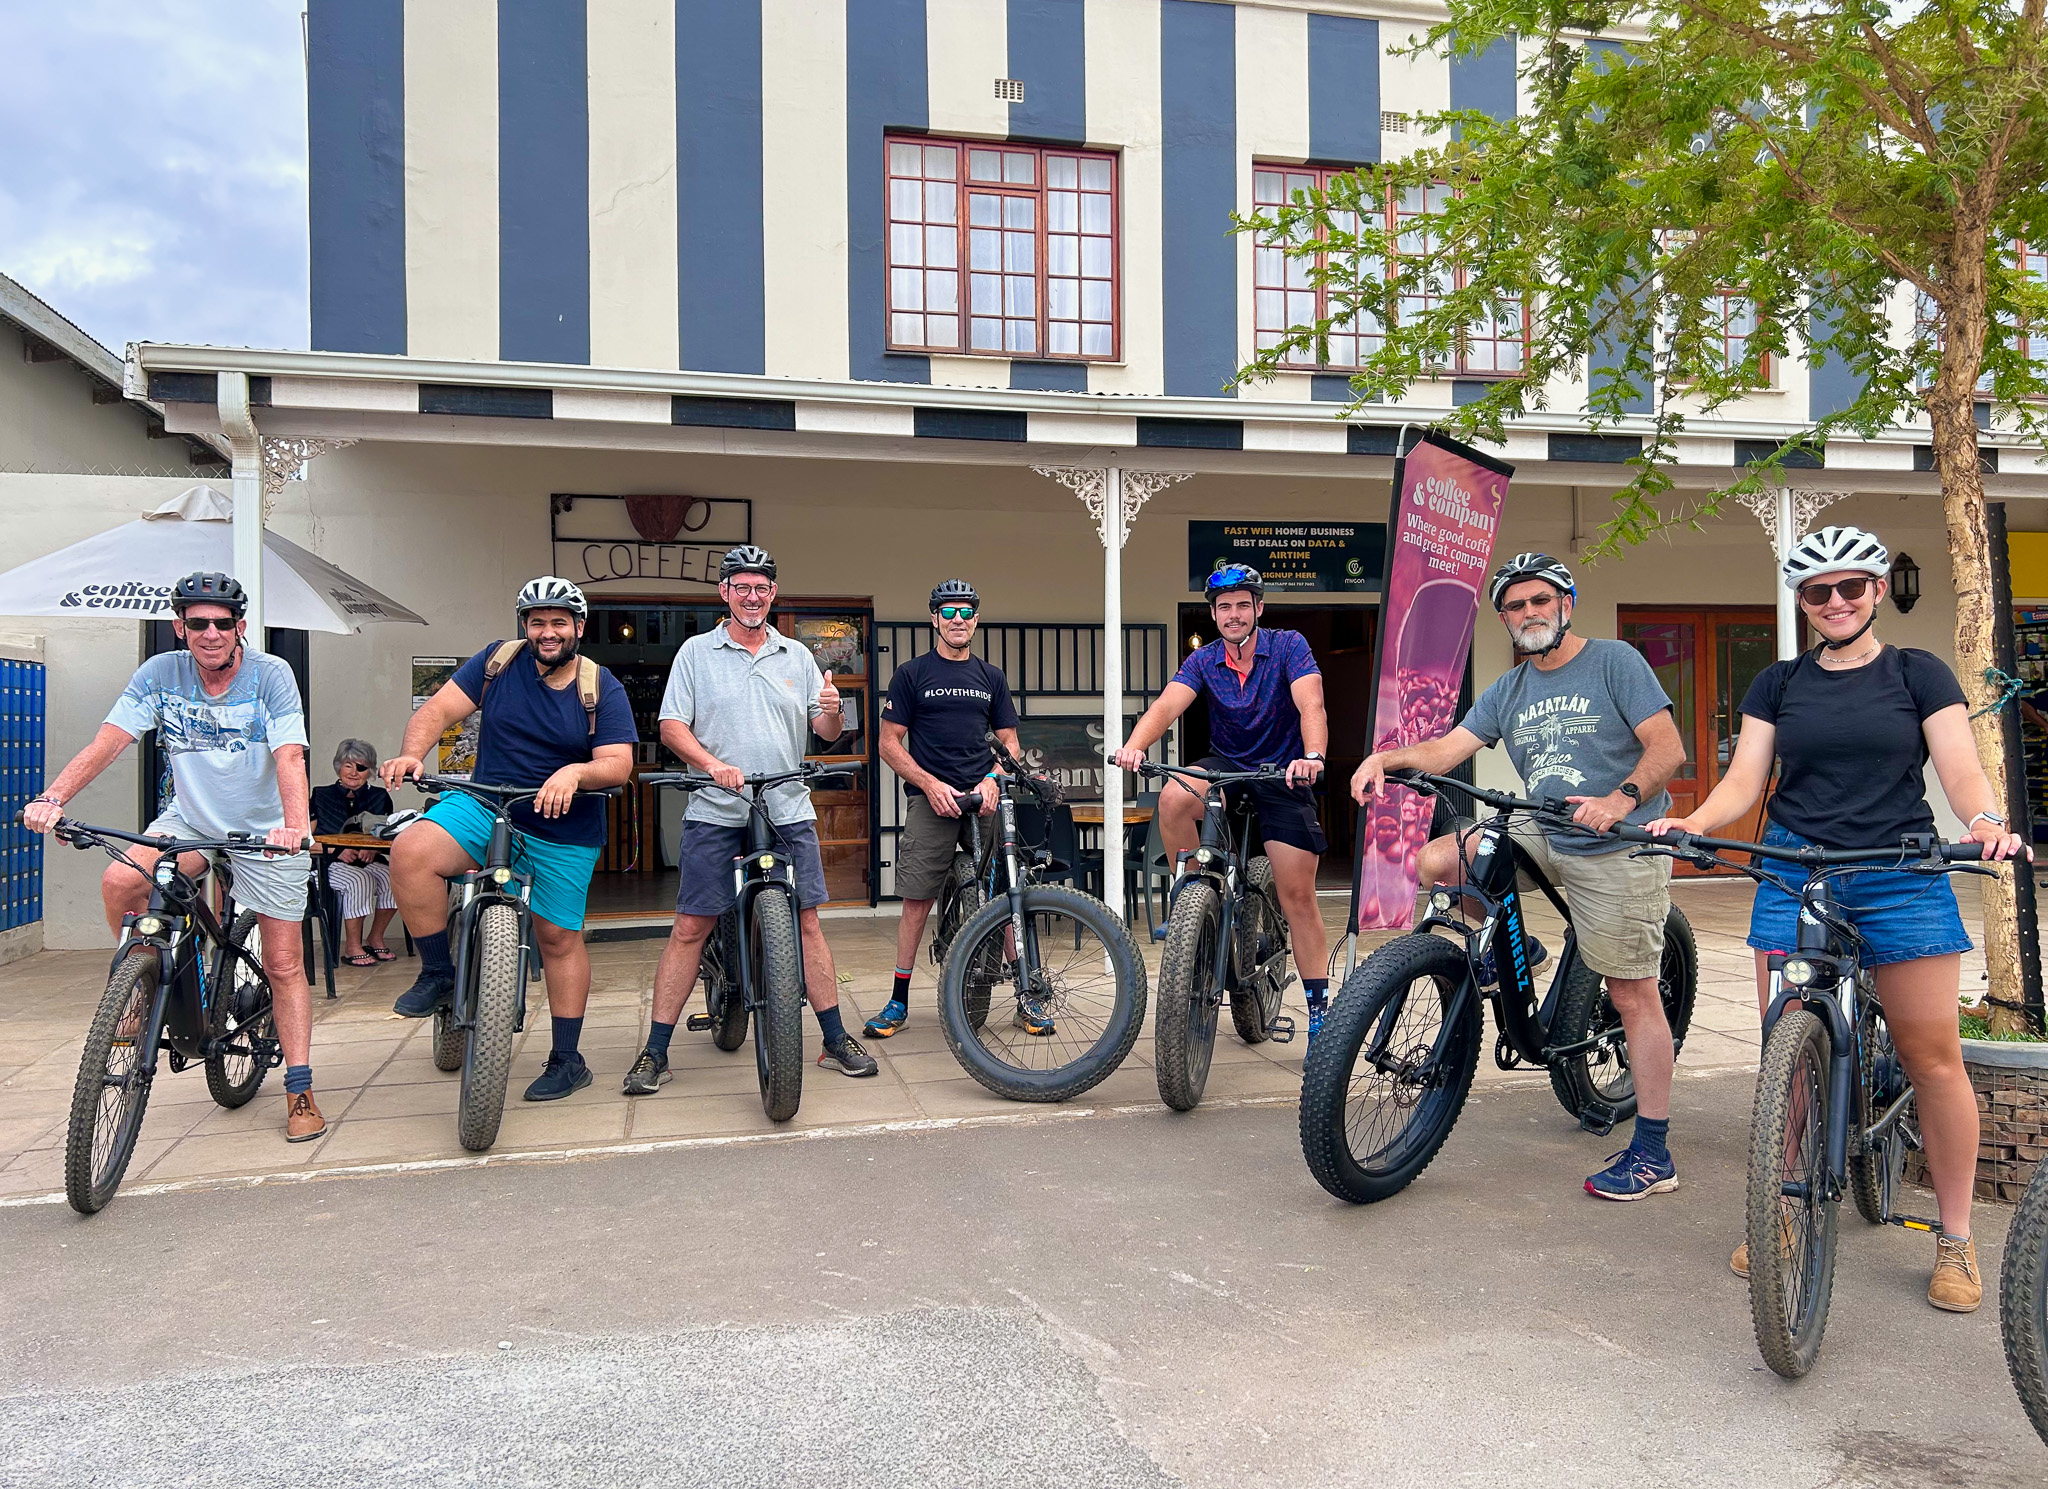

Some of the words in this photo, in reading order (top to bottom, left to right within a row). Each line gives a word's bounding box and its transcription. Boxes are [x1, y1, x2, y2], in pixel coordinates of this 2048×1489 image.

[1426, 476, 1471, 507] coffee
[1413, 482, 1425, 506] &
[1428, 493, 1495, 539] company
[1224, 527, 1248, 535] FAST
[1250, 527, 1273, 535] WIFI
[1275, 527, 1307, 536] HOME/
[1310, 528, 1354, 536] BUSINESS
[1407, 512, 1437, 536] Where
[1438, 528, 1464, 546] good
[1233, 539, 1256, 547] BEST
[1258, 539, 1288, 547] DEALS
[1338, 540, 1346, 548] &
[1403, 531, 1423, 547] and
[1422, 538, 1449, 557] great
[583, 543, 725, 582] COFFEE
[1269, 551, 1311, 559] AIRTIME
[1262, 571, 1293, 579] SIGNUP
[1428, 556, 1460, 576] meet!
[82, 581, 172, 597] coffee
[59, 592, 82, 607] &
[924, 688, 992, 702] #LOVETHERIDE
[1518, 693, 1591, 728] MAZATLÁN
[1564, 724, 1598, 736] APPAREL
[1503, 892, 1529, 993] E-WHEELZ
